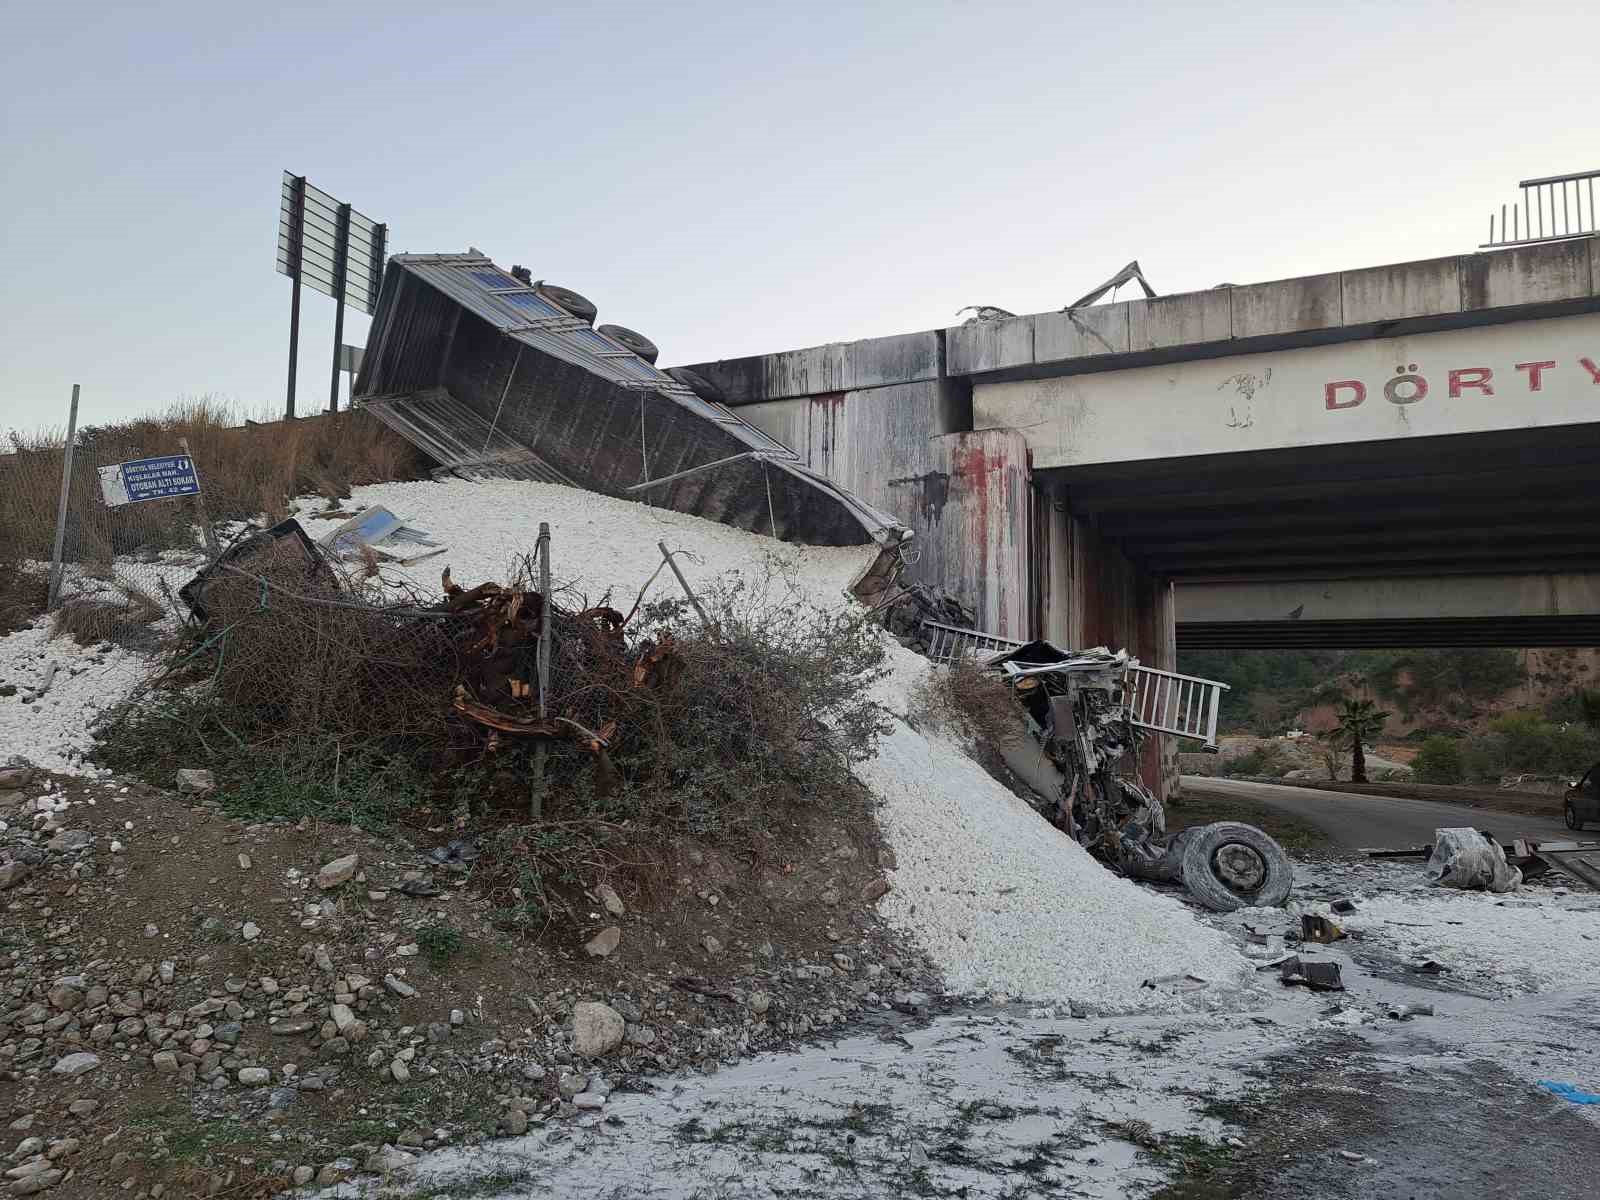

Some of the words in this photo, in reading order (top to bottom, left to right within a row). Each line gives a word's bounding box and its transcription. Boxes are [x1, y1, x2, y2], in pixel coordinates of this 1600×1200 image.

[131, 480, 157, 491] OTOBAN
[158, 478, 172, 488] ALTI
[173, 476, 194, 486] SOKAK
